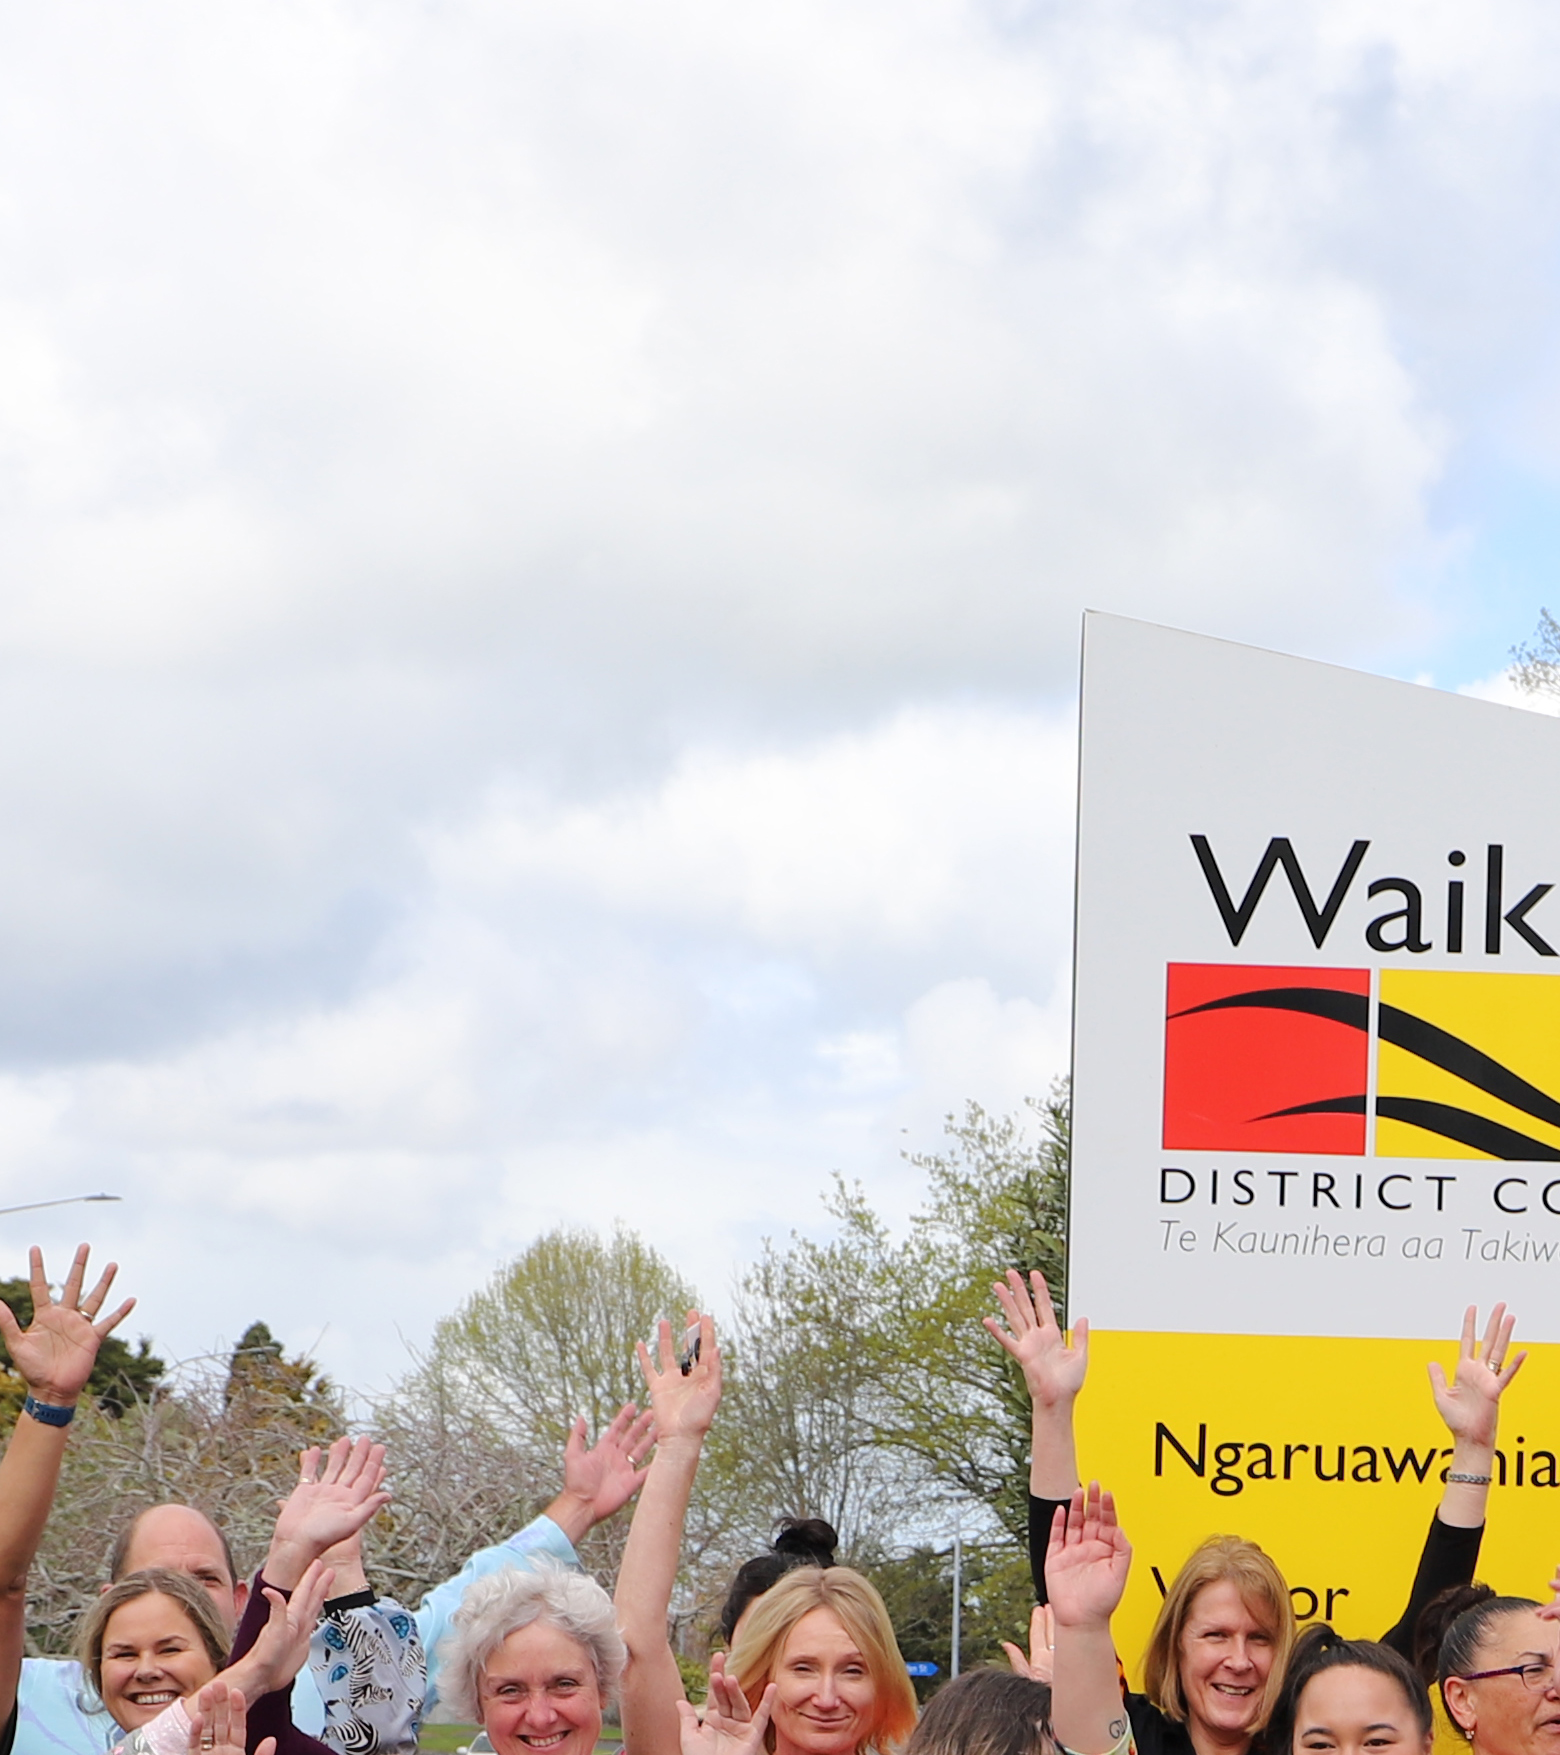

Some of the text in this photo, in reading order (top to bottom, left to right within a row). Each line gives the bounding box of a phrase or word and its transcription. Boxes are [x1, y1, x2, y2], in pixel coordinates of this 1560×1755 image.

[1159, 1168, 1457, 1212] DISTRICT
[1160, 1219, 1197, 1252] Te
[1213, 1221, 1386, 1257] Kaunihera
[1401, 1237, 1444, 1260] aa
